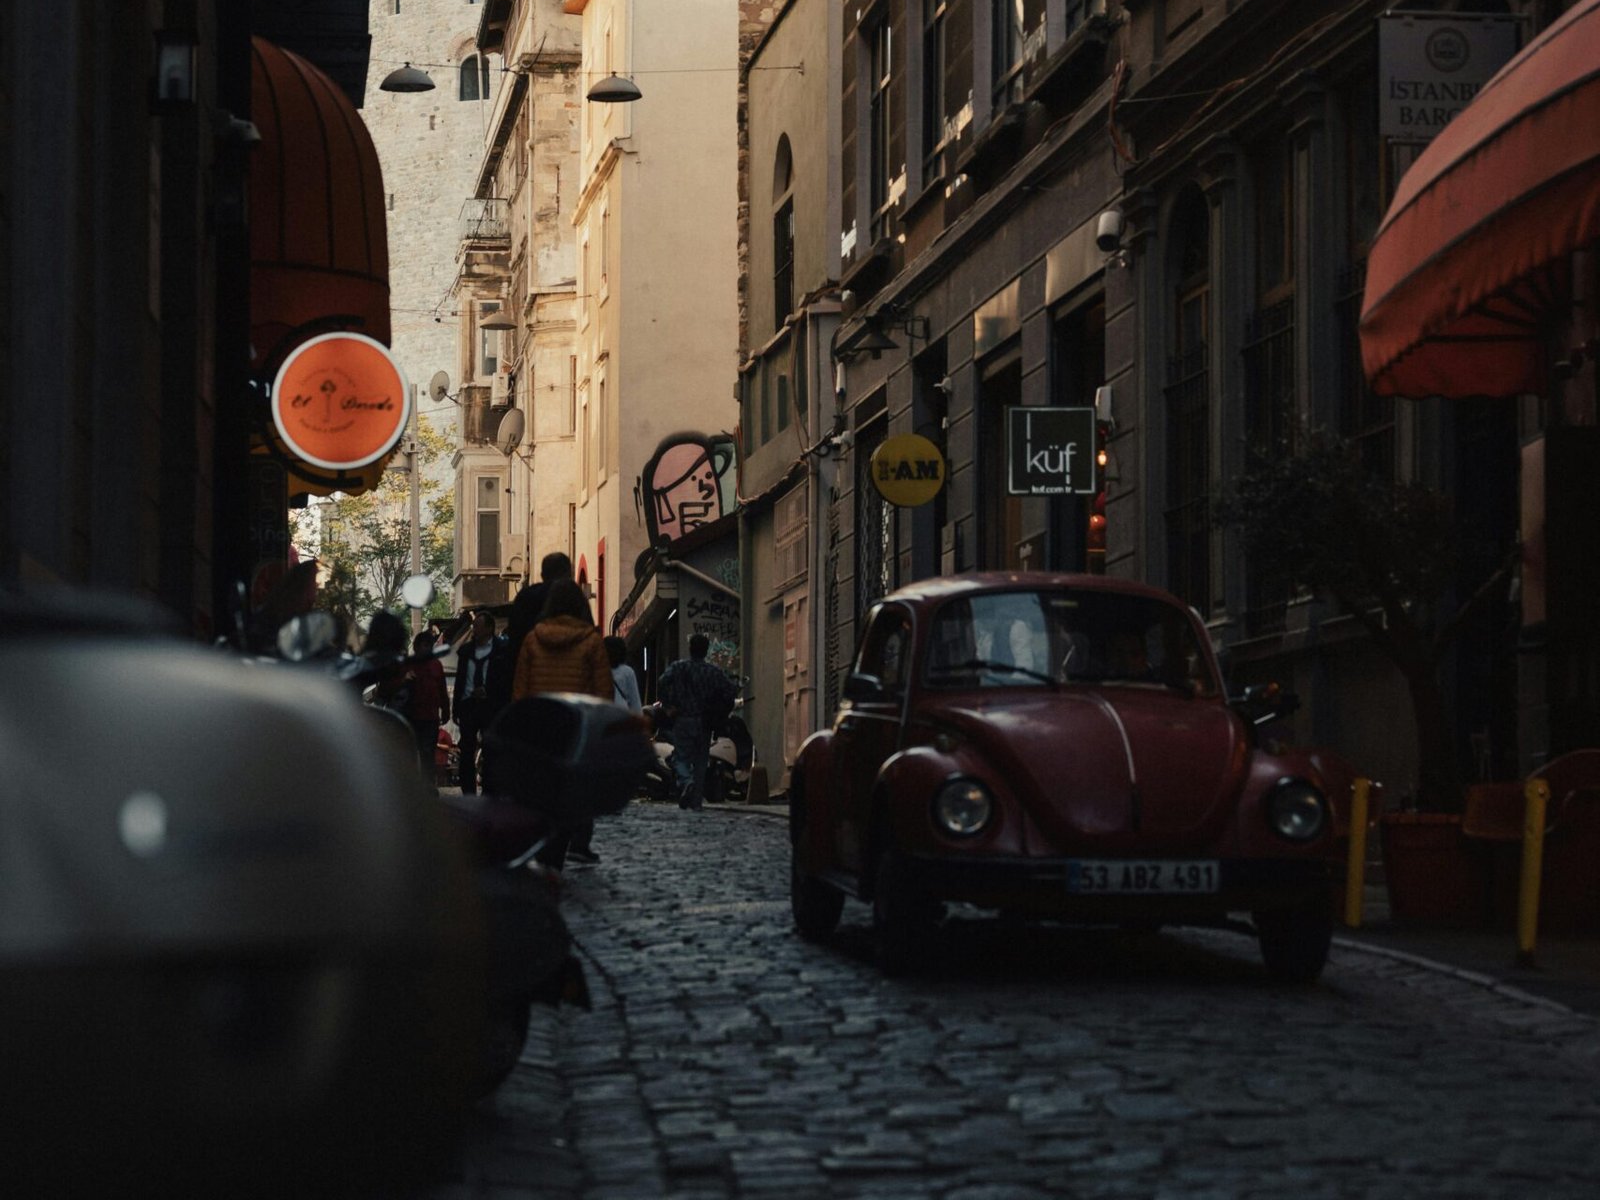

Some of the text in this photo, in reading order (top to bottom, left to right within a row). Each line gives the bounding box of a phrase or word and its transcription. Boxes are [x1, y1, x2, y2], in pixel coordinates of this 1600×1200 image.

[1389, 76, 1481, 101] İSTANB
[1026, 441, 1077, 475] küf
[1080, 865, 1109, 889] 53
[1174, 865, 1213, 889] 491
